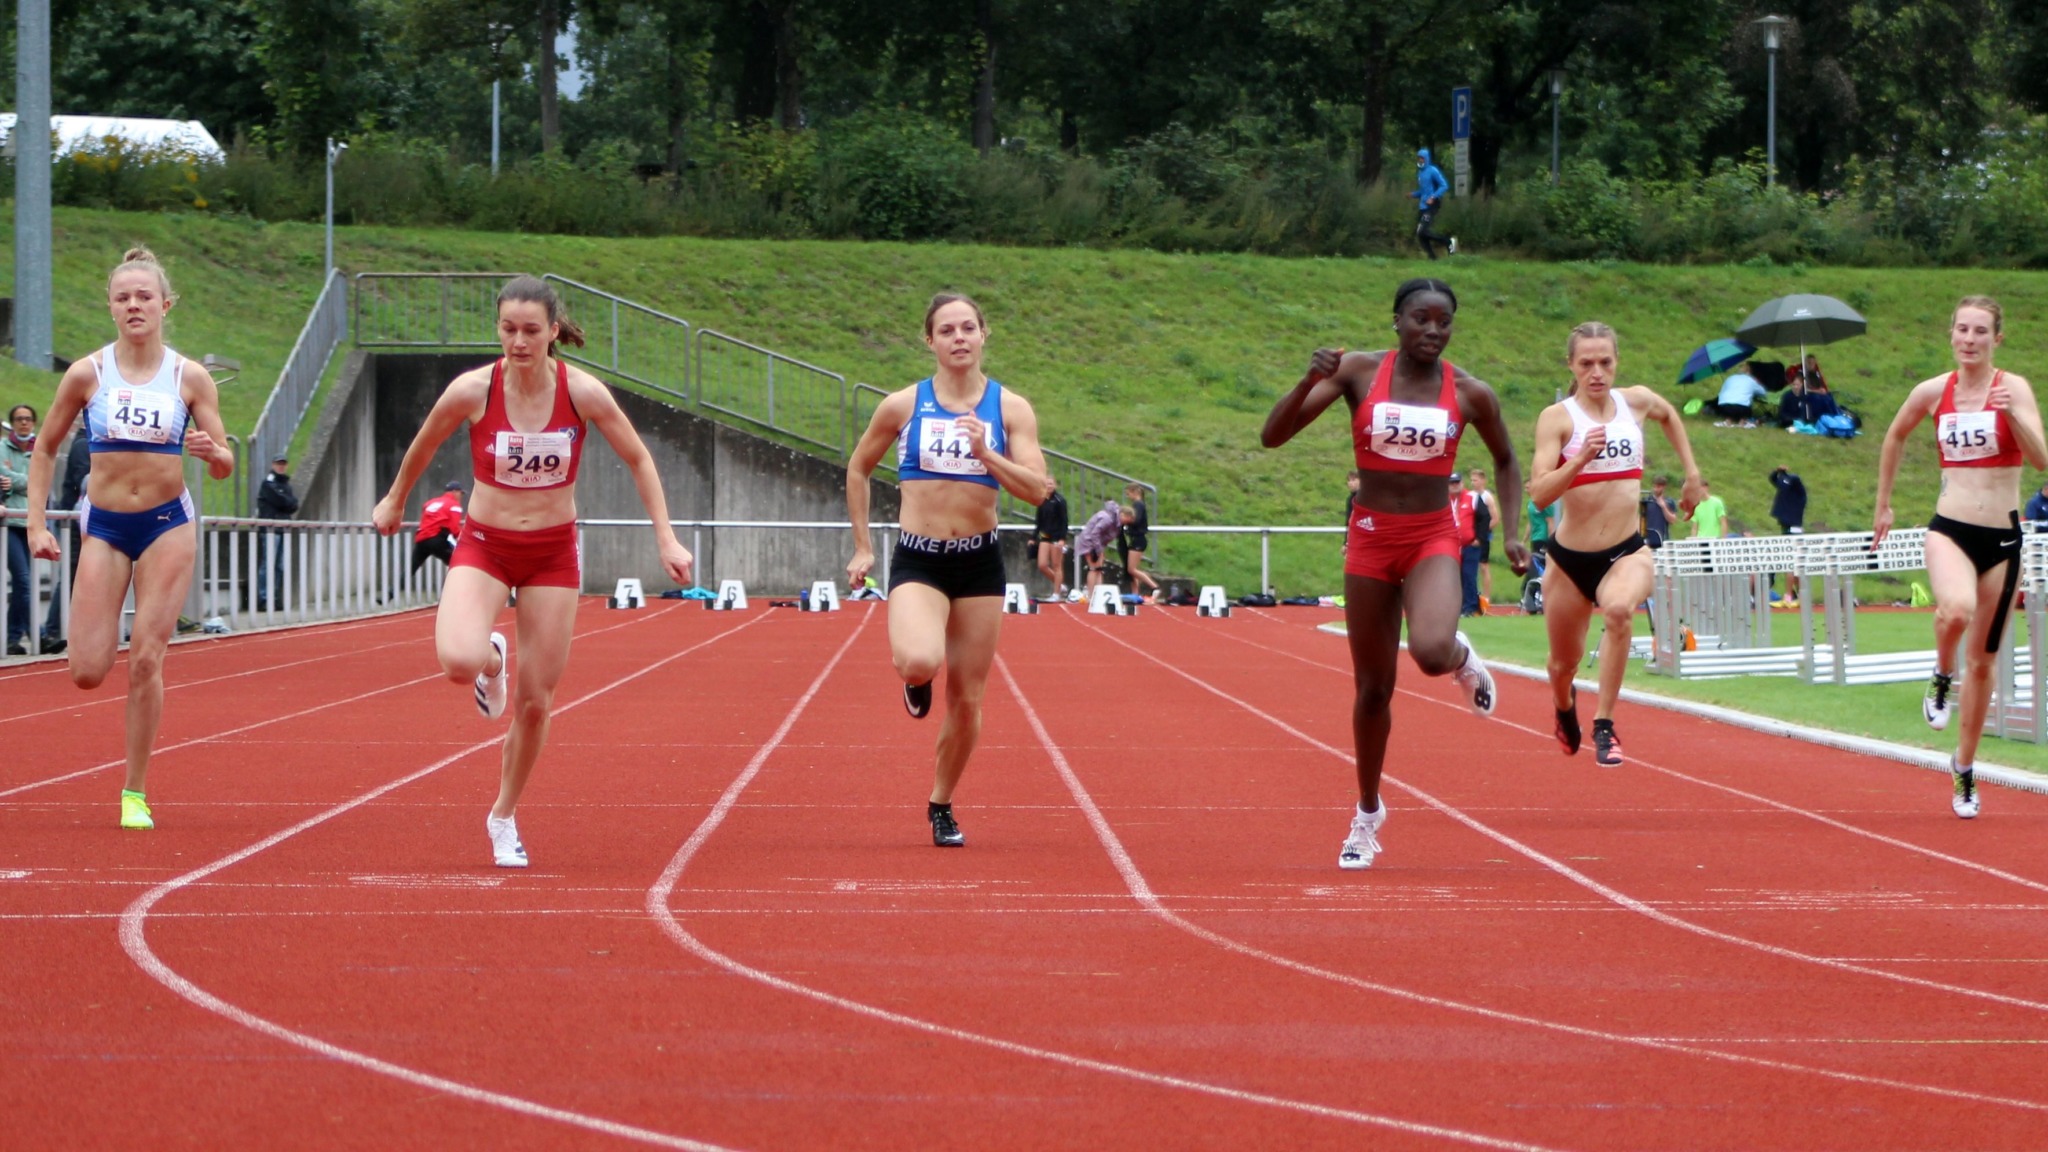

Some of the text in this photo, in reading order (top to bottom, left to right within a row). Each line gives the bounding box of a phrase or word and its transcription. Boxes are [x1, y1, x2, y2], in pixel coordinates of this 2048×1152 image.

[1456, 94, 1467, 133] P
[115, 406, 162, 430] 451
[1383, 425, 1436, 448] 236
[1946, 429, 1987, 448] 415
[507, 454, 560, 475] 249
[900, 530, 940, 553] NIKE
[943, 534, 982, 554] PRO
[1715, 545, 1794, 556] EIDERSTADIO
[1882, 550, 1922, 559] EIDER
[1883, 559, 1923, 569] EIDER
[623, 584, 634, 600] 7
[726, 586, 737, 602] 6
[818, 587, 829, 602] 5
[1008, 590, 1019, 604] 3
[1103, 591, 1114, 605] 2
[1208, 592, 1216, 609] 1
